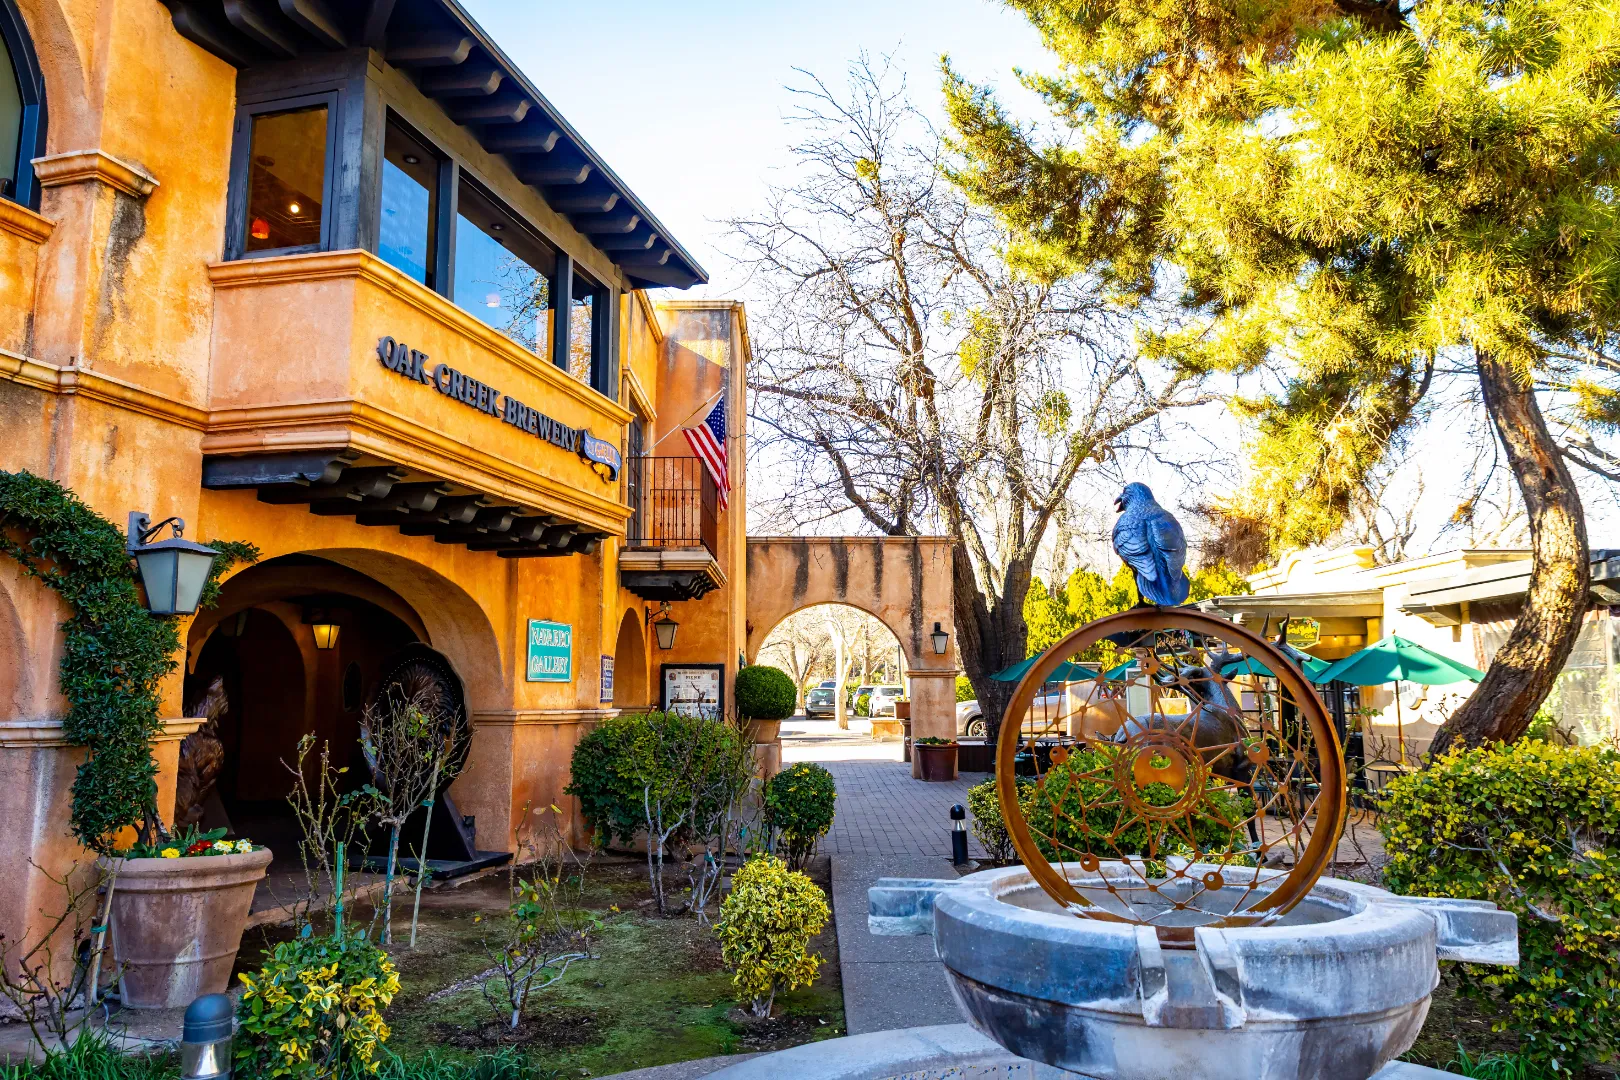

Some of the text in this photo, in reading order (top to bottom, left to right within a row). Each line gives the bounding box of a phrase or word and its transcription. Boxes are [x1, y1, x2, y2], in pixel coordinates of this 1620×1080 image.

[377, 336, 576, 452] OAK CREEK BREWERY
[532, 655, 568, 674] GALLERY
